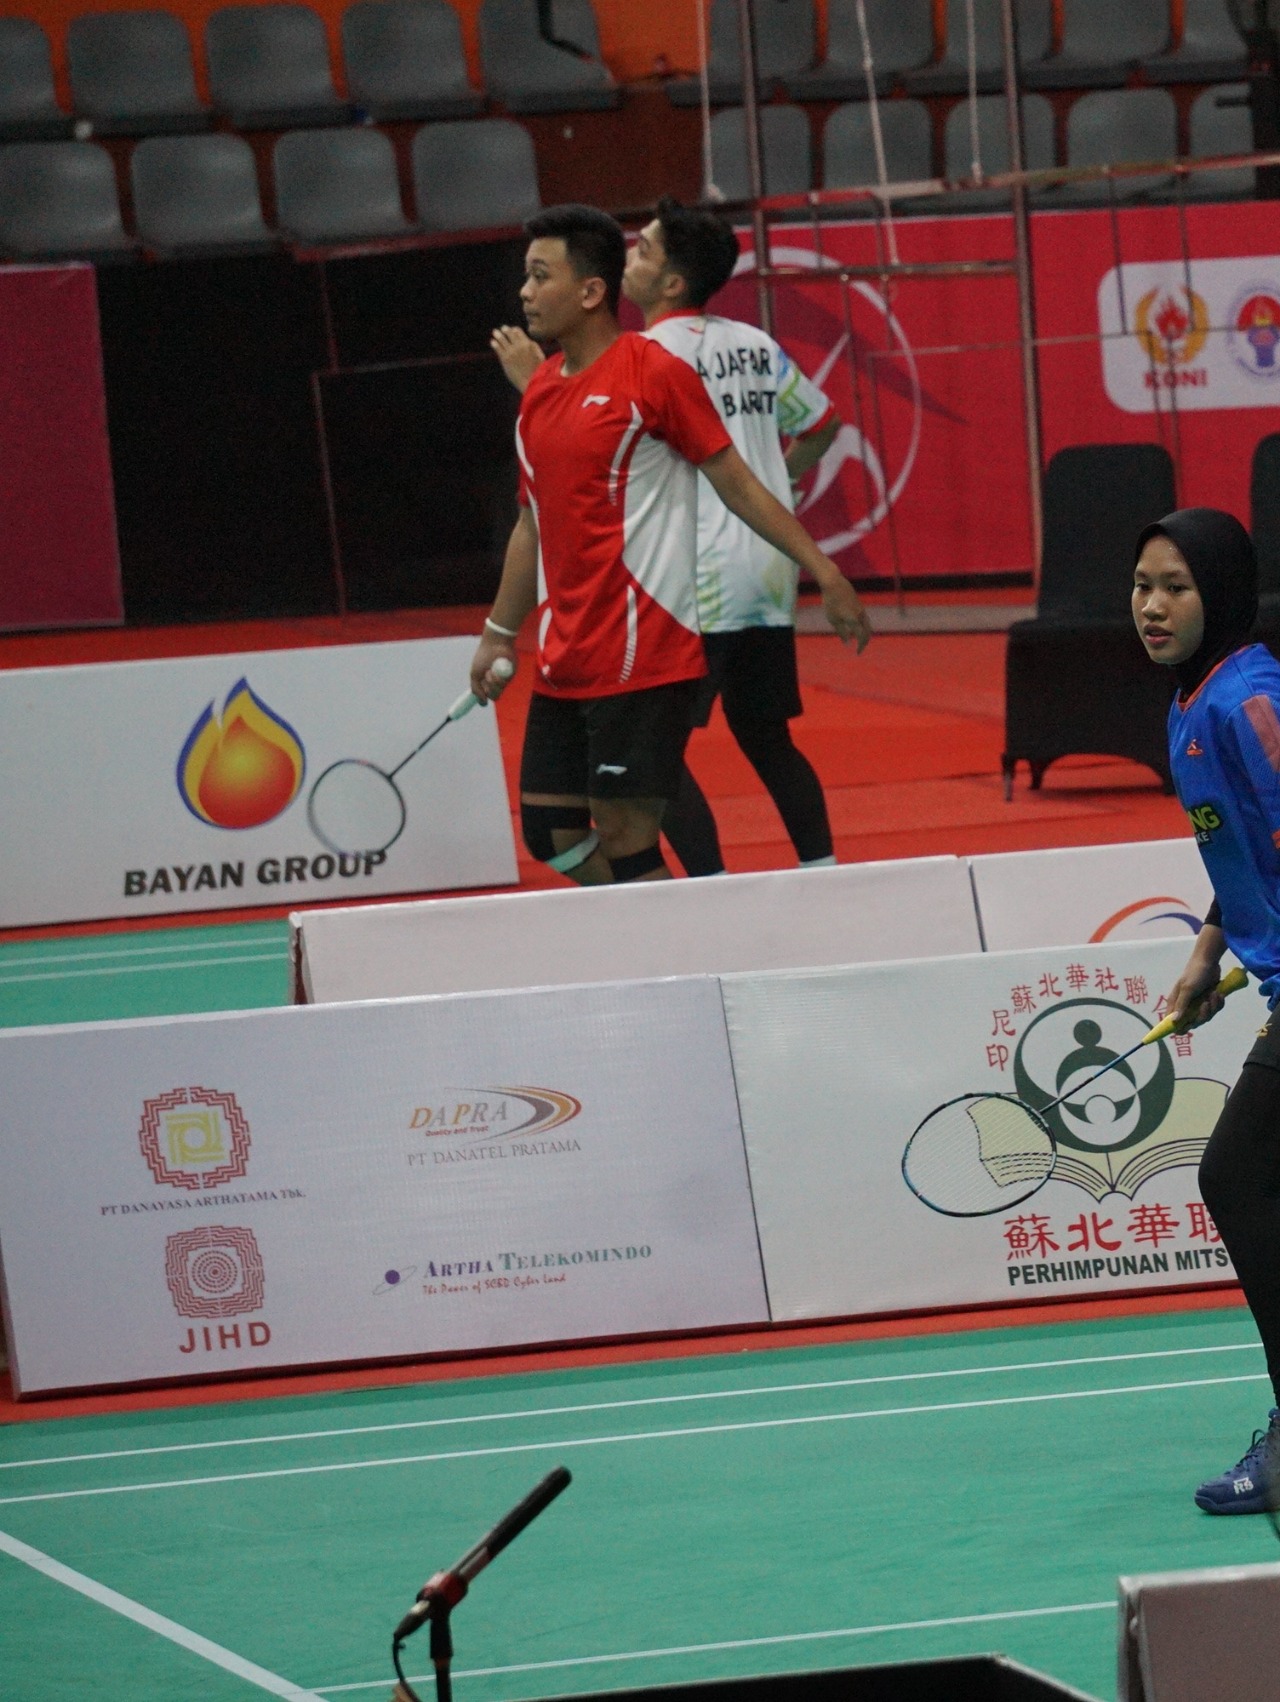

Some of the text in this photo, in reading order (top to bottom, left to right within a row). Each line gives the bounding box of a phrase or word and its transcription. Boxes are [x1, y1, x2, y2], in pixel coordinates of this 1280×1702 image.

[716, 346, 772, 379] JAFAR
[123, 850, 388, 897] BAYAN GROUP
[409, 1100, 508, 1130] DAPRA
[407, 1139, 582, 1167] PT DANATEL PRATAMA
[101, 1205, 119, 1216] PT
[425, 1259, 495, 1278] ARTHA
[1007, 1247, 1230, 1287] PERHIMPUNAN MITS
[179, 1321, 271, 1354] JIHD
